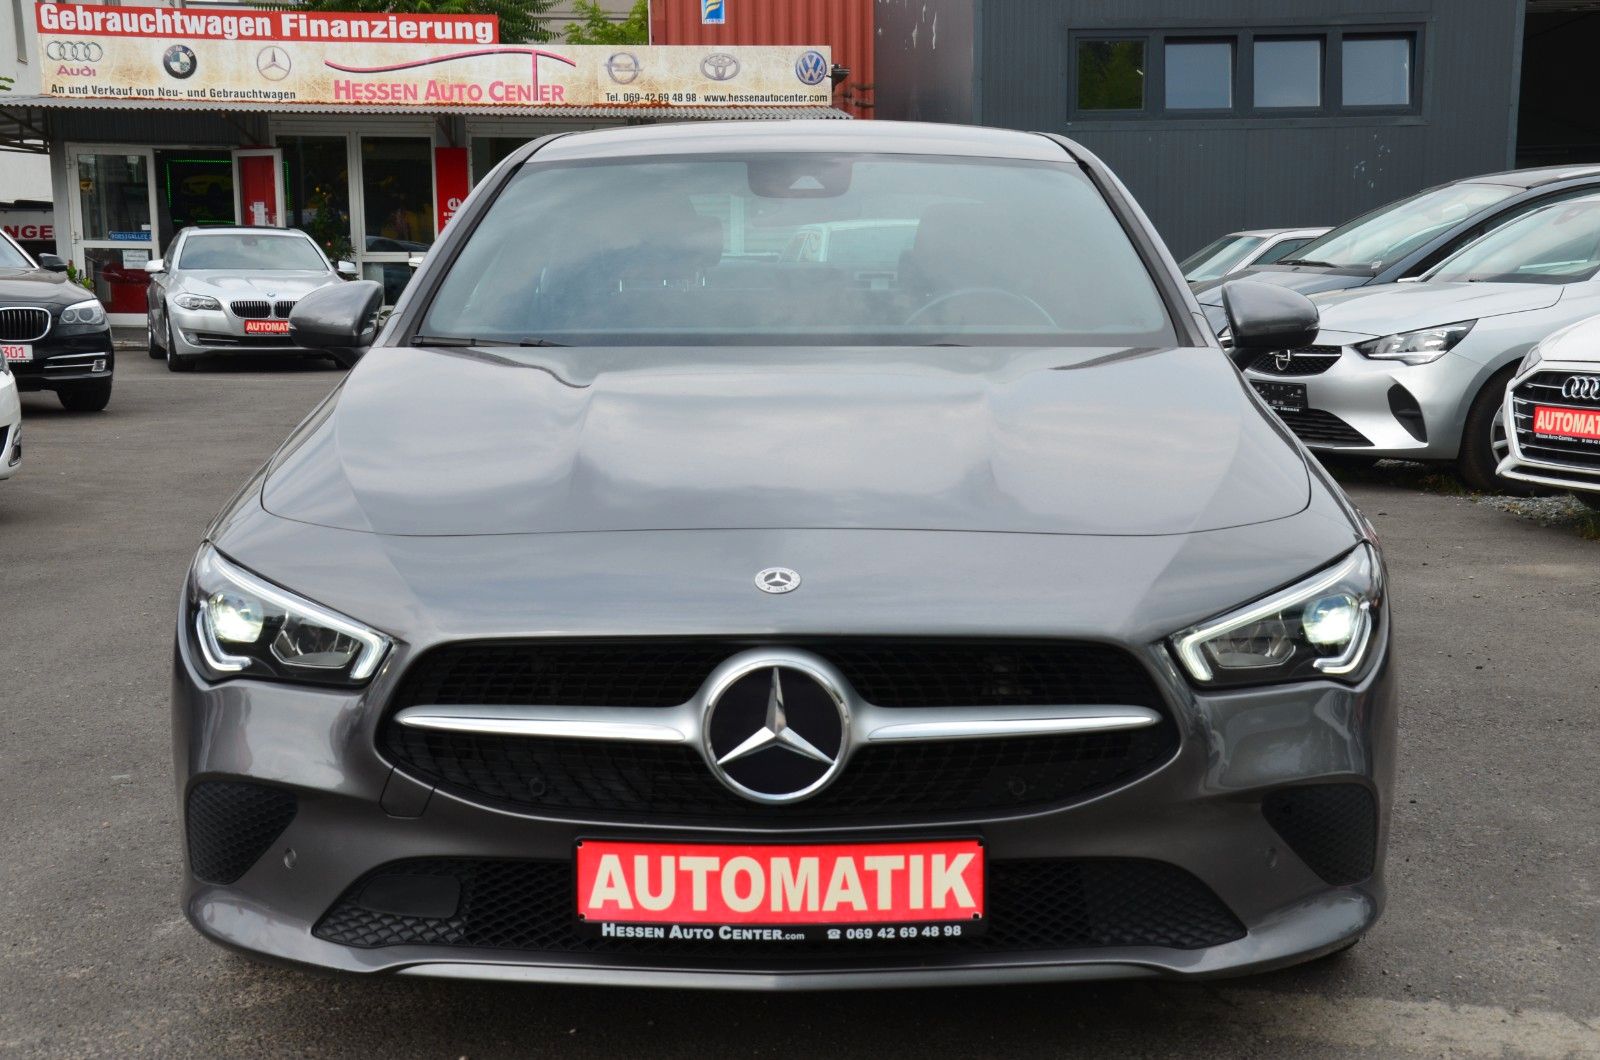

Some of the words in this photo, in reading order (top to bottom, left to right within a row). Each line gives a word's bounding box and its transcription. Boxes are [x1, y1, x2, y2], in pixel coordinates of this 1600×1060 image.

[40, 3, 271, 39] Gebrauchtwagen
[281, 14, 494, 44] Finanzierung
[57, 65, 97, 77] Audi
[52, 84, 64, 94] An
[68, 85, 88, 95] und
[92, 86, 132, 96] Verkauf
[136, 88, 154, 96] von
[158, 88, 182, 97] Neu-
[187, 89, 206, 98] und
[210, 89, 296, 99] Gebrauchtwagen
[606, 93, 621, 102] Tel.
[658, 93, 669, 102] 69
[672, 93, 683, 102] 48
[686, 93, 697, 102] 98
[703, 93, 828, 102] www.hessenautocenter.com
[588, 853, 976, 912] AUTOMATIK
[846, 928, 873, 940] 069
[877, 927, 896, 939] 42
[899, 927, 918, 938] 69
[921, 926, 940, 937] 48
[943, 925, 962, 937] 98
